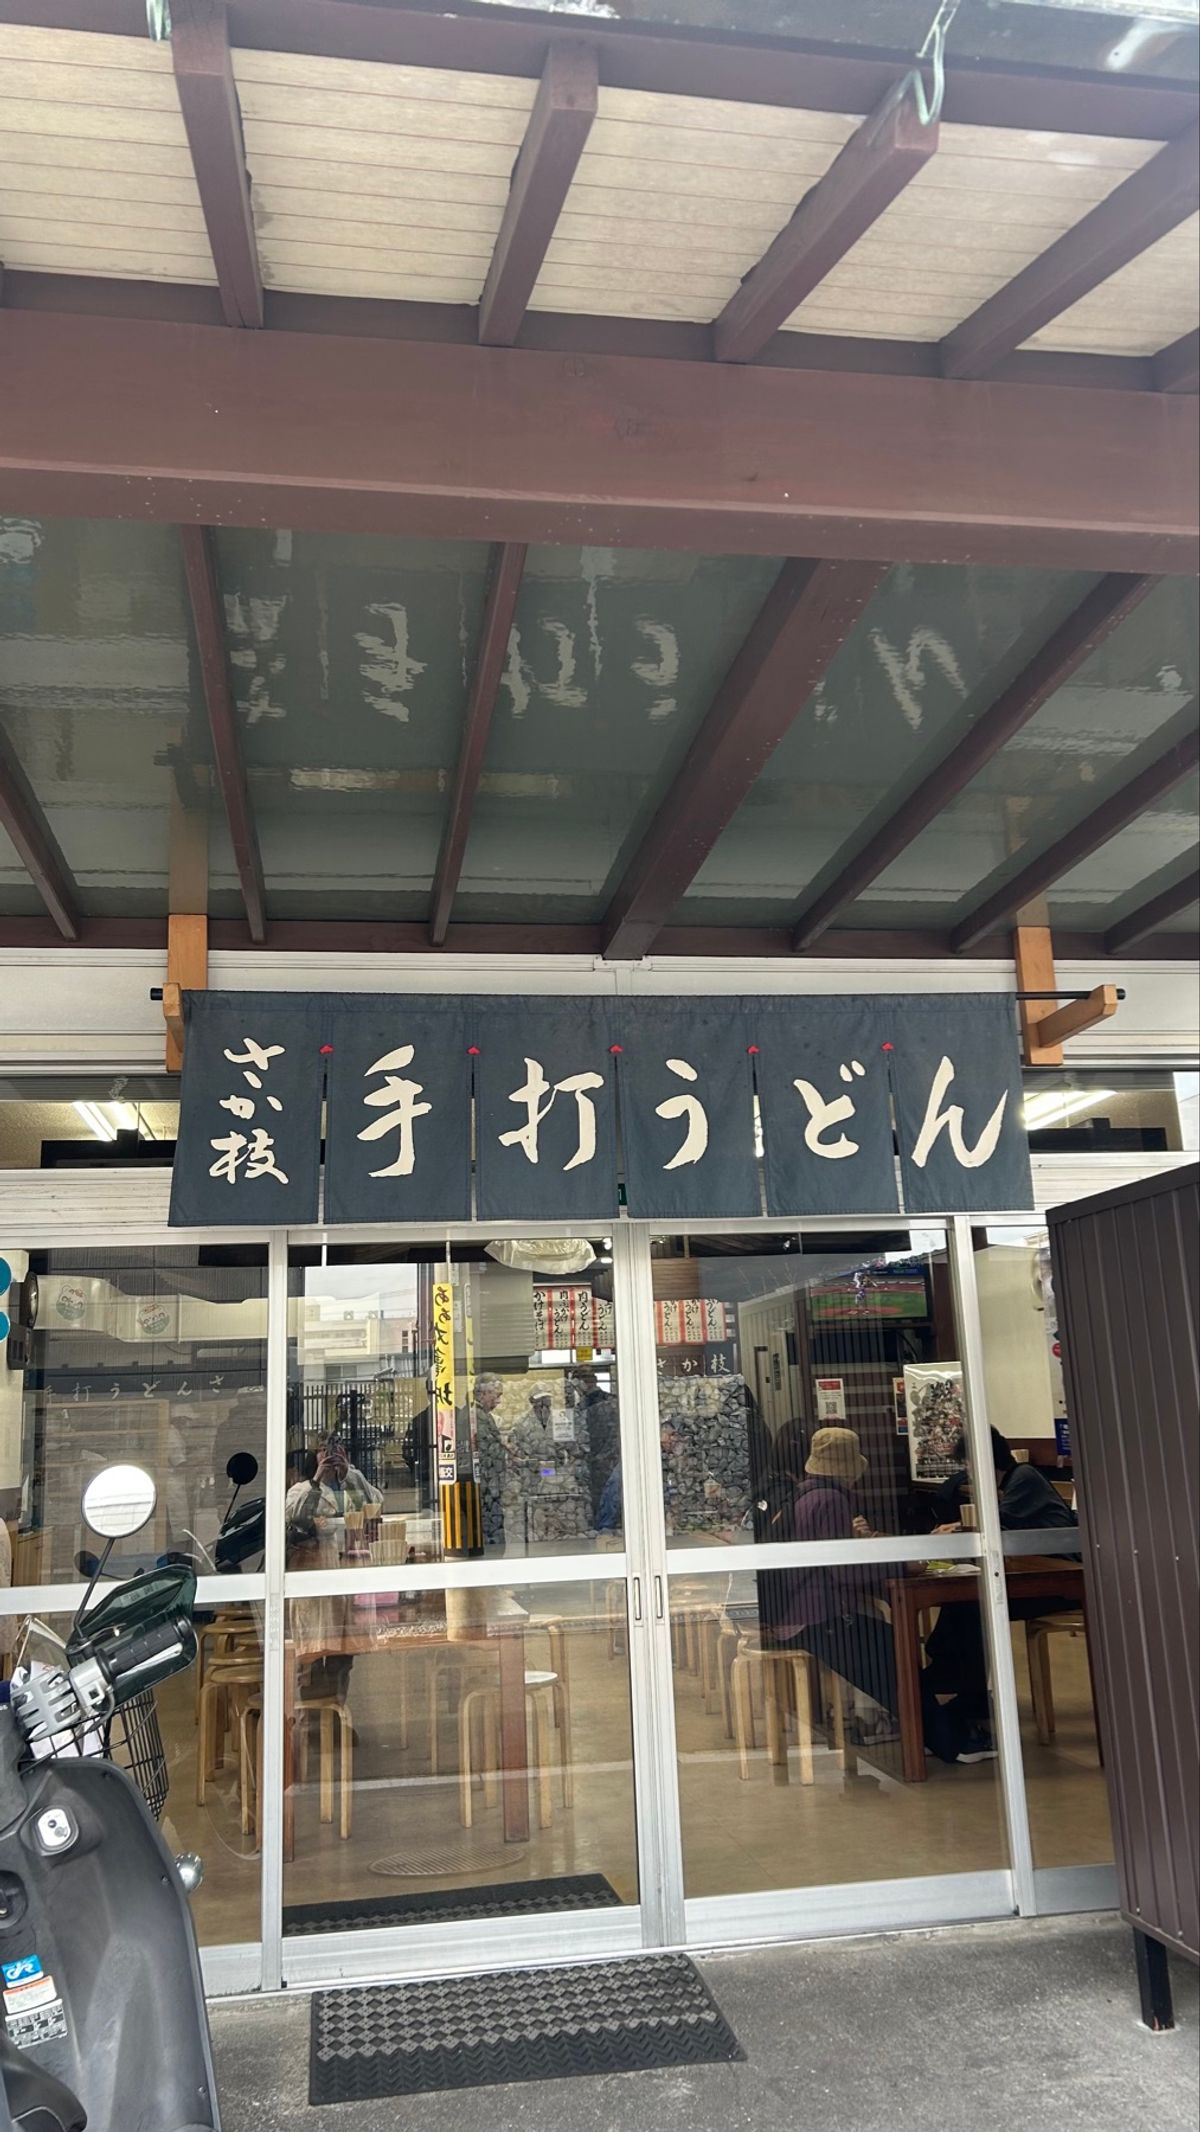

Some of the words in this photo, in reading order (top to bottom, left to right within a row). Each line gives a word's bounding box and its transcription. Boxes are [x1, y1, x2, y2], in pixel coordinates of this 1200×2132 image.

[208, 1037, 290, 1185] さか枝
[355, 1044, 1009, 1178] 手打うどん
